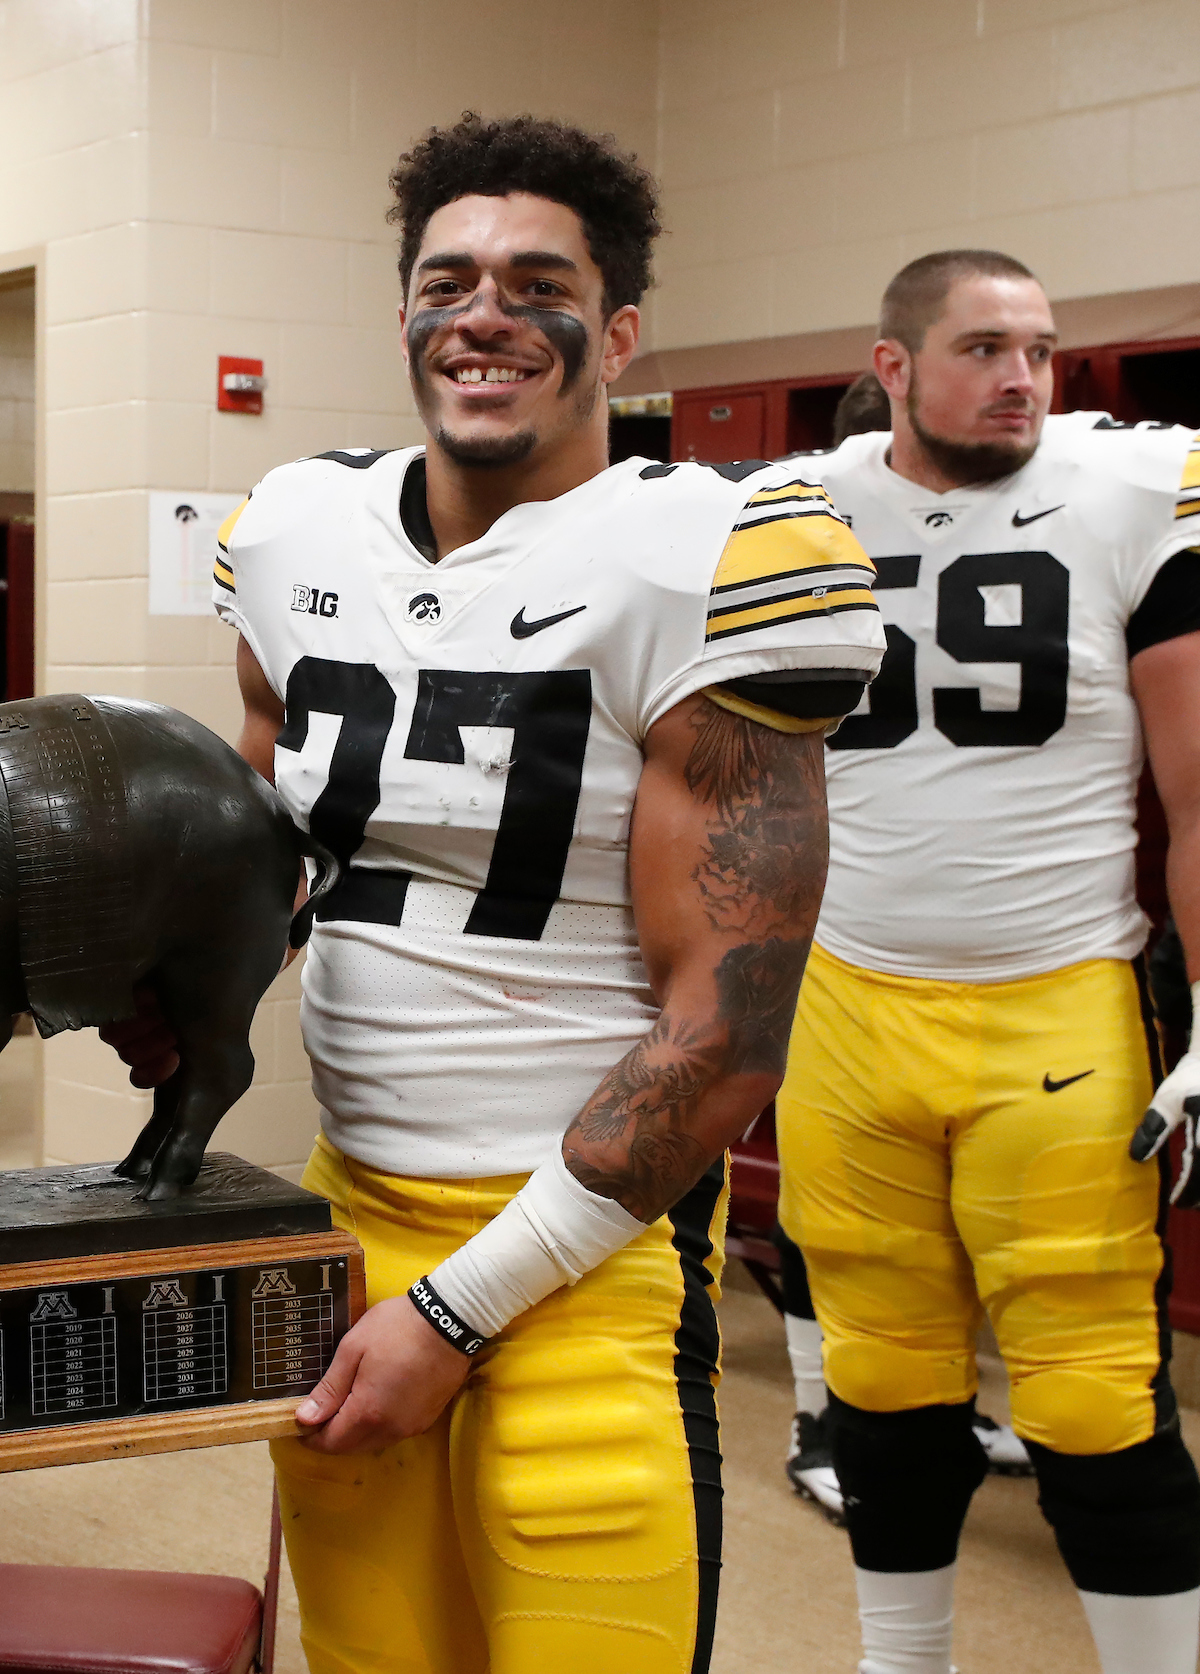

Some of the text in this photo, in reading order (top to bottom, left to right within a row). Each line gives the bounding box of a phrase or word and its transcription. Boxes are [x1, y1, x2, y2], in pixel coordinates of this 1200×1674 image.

[824, 552, 1069, 749] 59
[275, 656, 592, 940] 27
[284, 1300, 301, 1309] 2033
[176, 1311, 193, 1320] 2026
[285, 1312, 302, 1321] 2034
[65, 1324, 83, 1333] 2019
[176, 1324, 194, 1333] 2027
[285, 1324, 302, 1333] 2035
[65, 1336, 83, 1346] 2020
[176, 1336, 194, 1345] 2028
[285, 1337, 302, 1345] 2036
[65, 1349, 82, 1358] 2021
[177, 1349, 194, 1358] 2029
[285, 1349, 302, 1358] 2037
[65, 1361, 83, 1371] 2022
[177, 1361, 194, 1370] 2030
[285, 1361, 302, 1370] 2038
[66, 1374, 83, 1383] 2023
[177, 1374, 194, 1383] 2031
[286, 1373, 302, 1382] 2039
[66, 1386, 84, 1396] 2024
[177, 1386, 195, 1395] 2032
[66, 1399, 84, 1408] 2025
